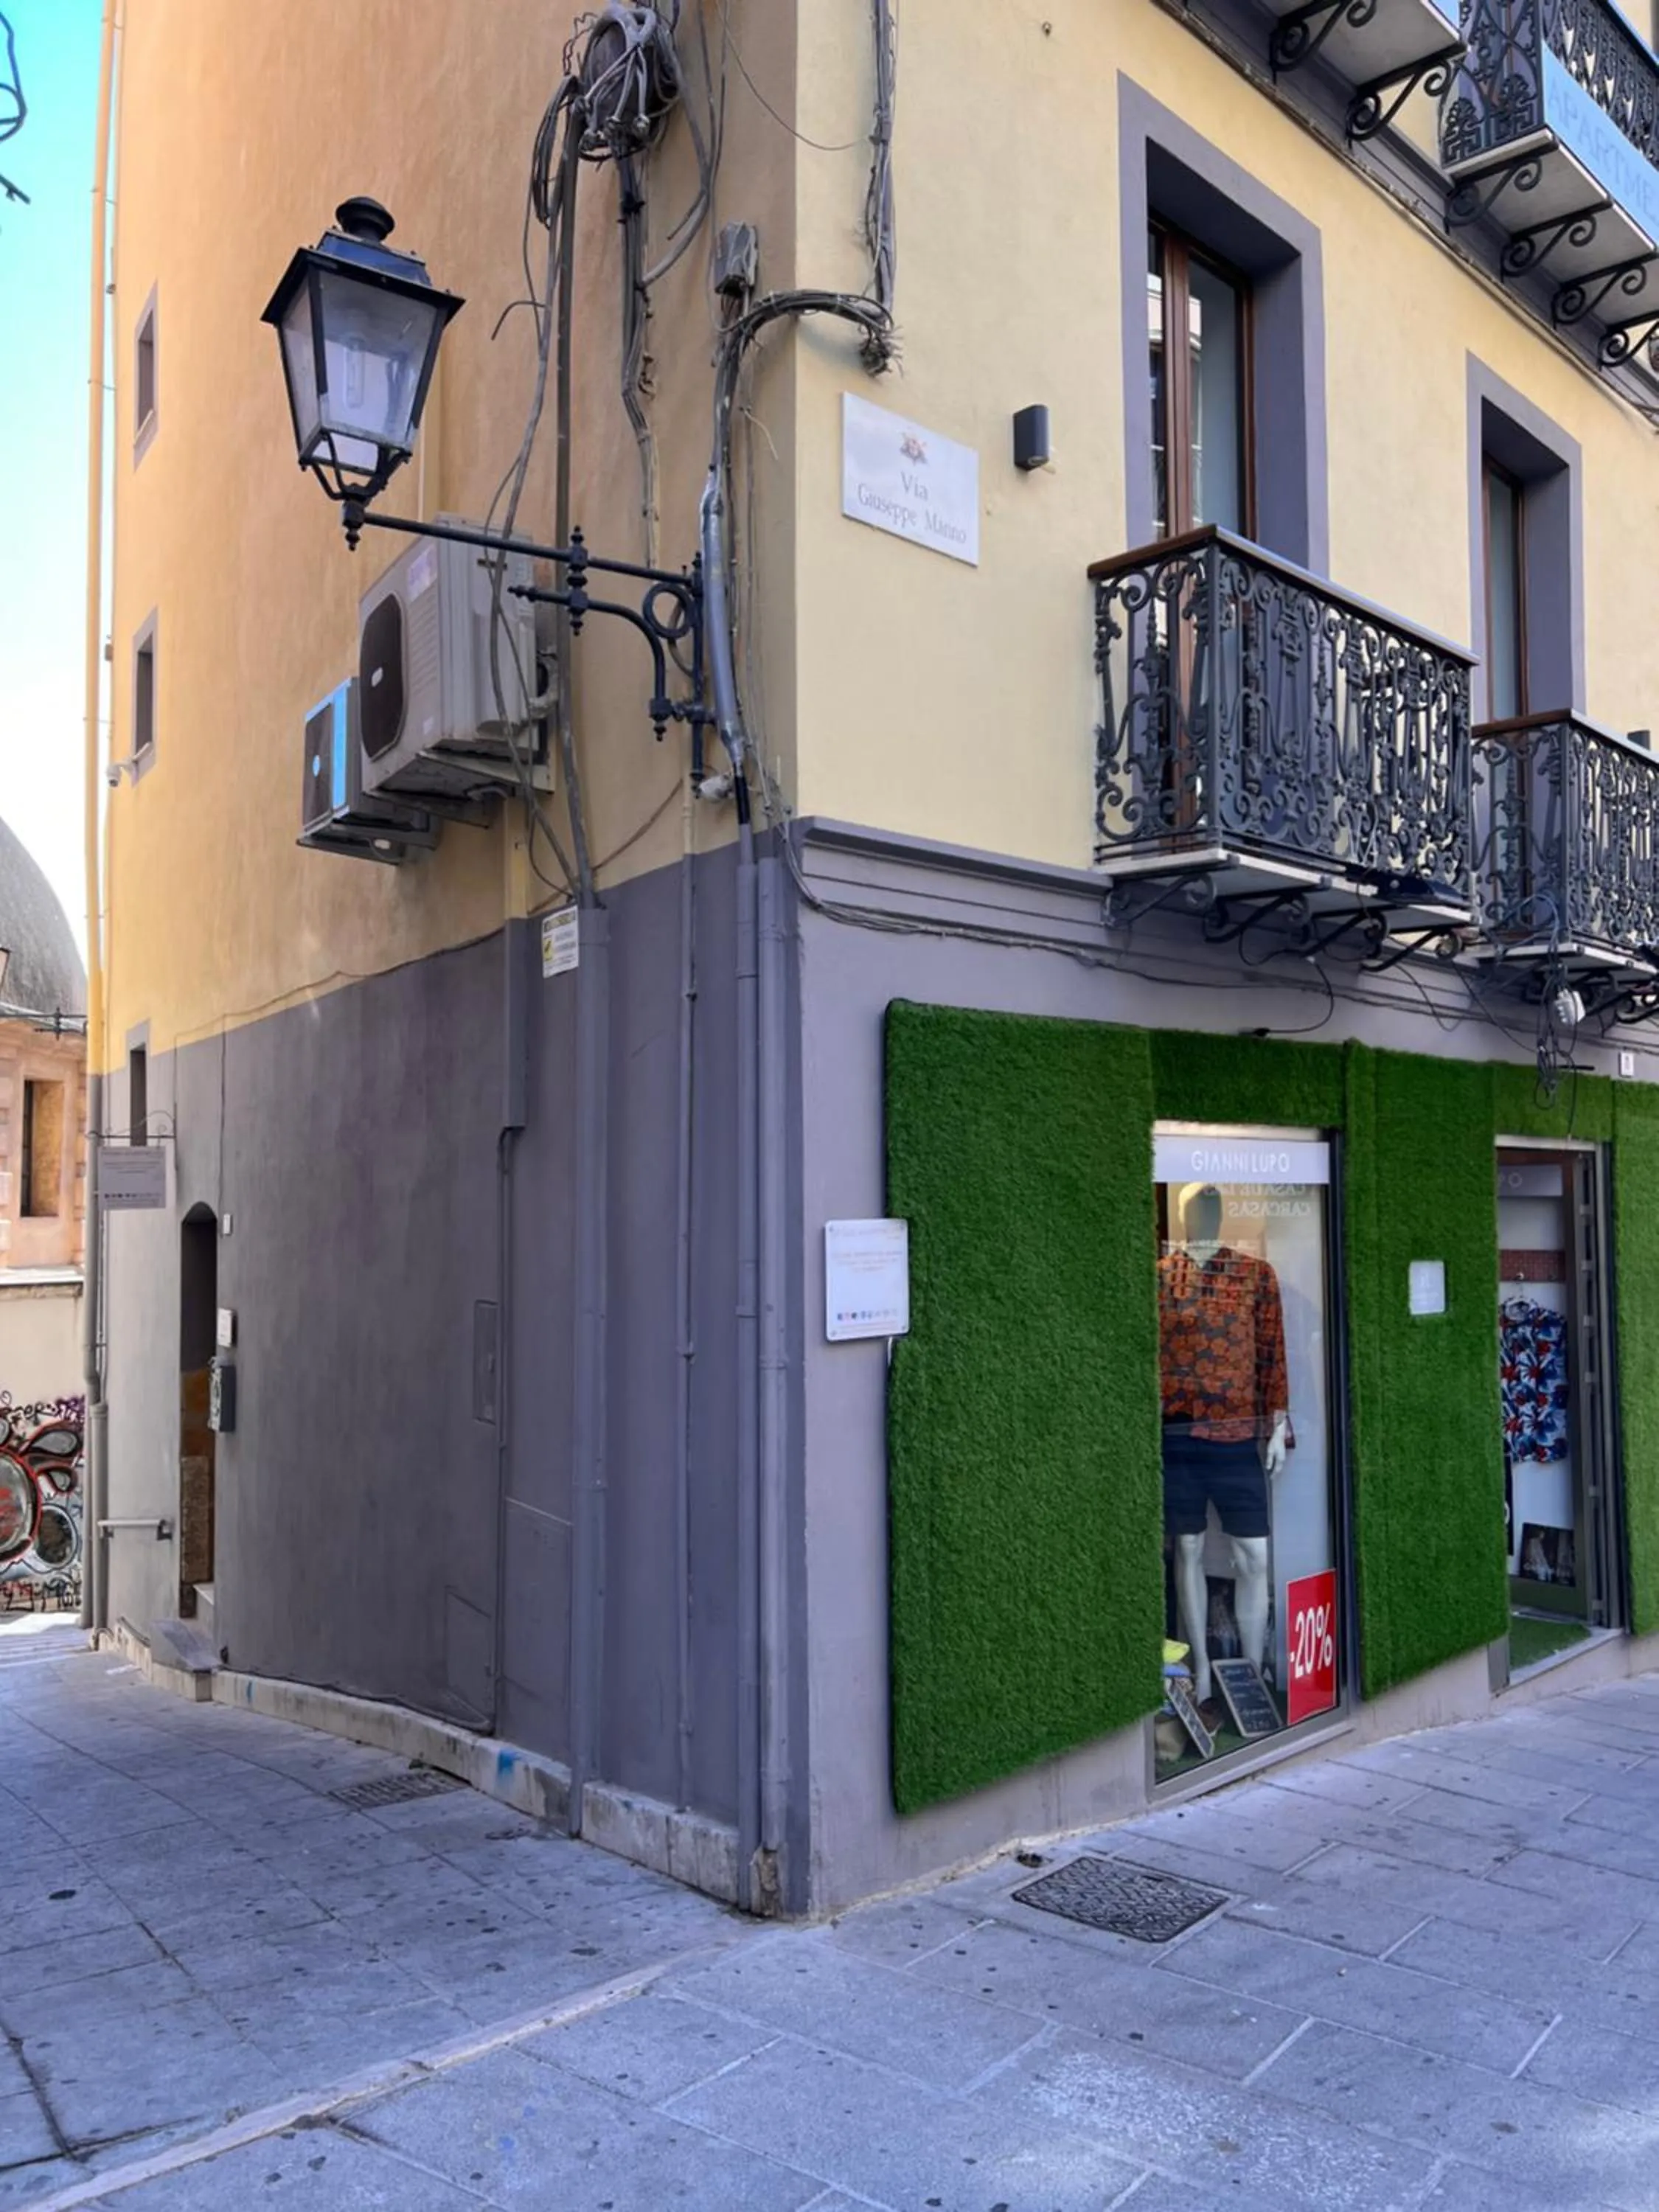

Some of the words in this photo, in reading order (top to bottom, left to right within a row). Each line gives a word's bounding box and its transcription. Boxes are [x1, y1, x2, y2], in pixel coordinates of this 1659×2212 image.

[900, 470, 928, 501] Via
[858, 482, 917, 529] Giuseppe
[925, 509, 967, 544] Manno
[1190, 1150, 1248, 1172] GIANNI
[1253, 1152, 1290, 1173] LUPO
[1289, 1602, 1333, 1679] -20%
